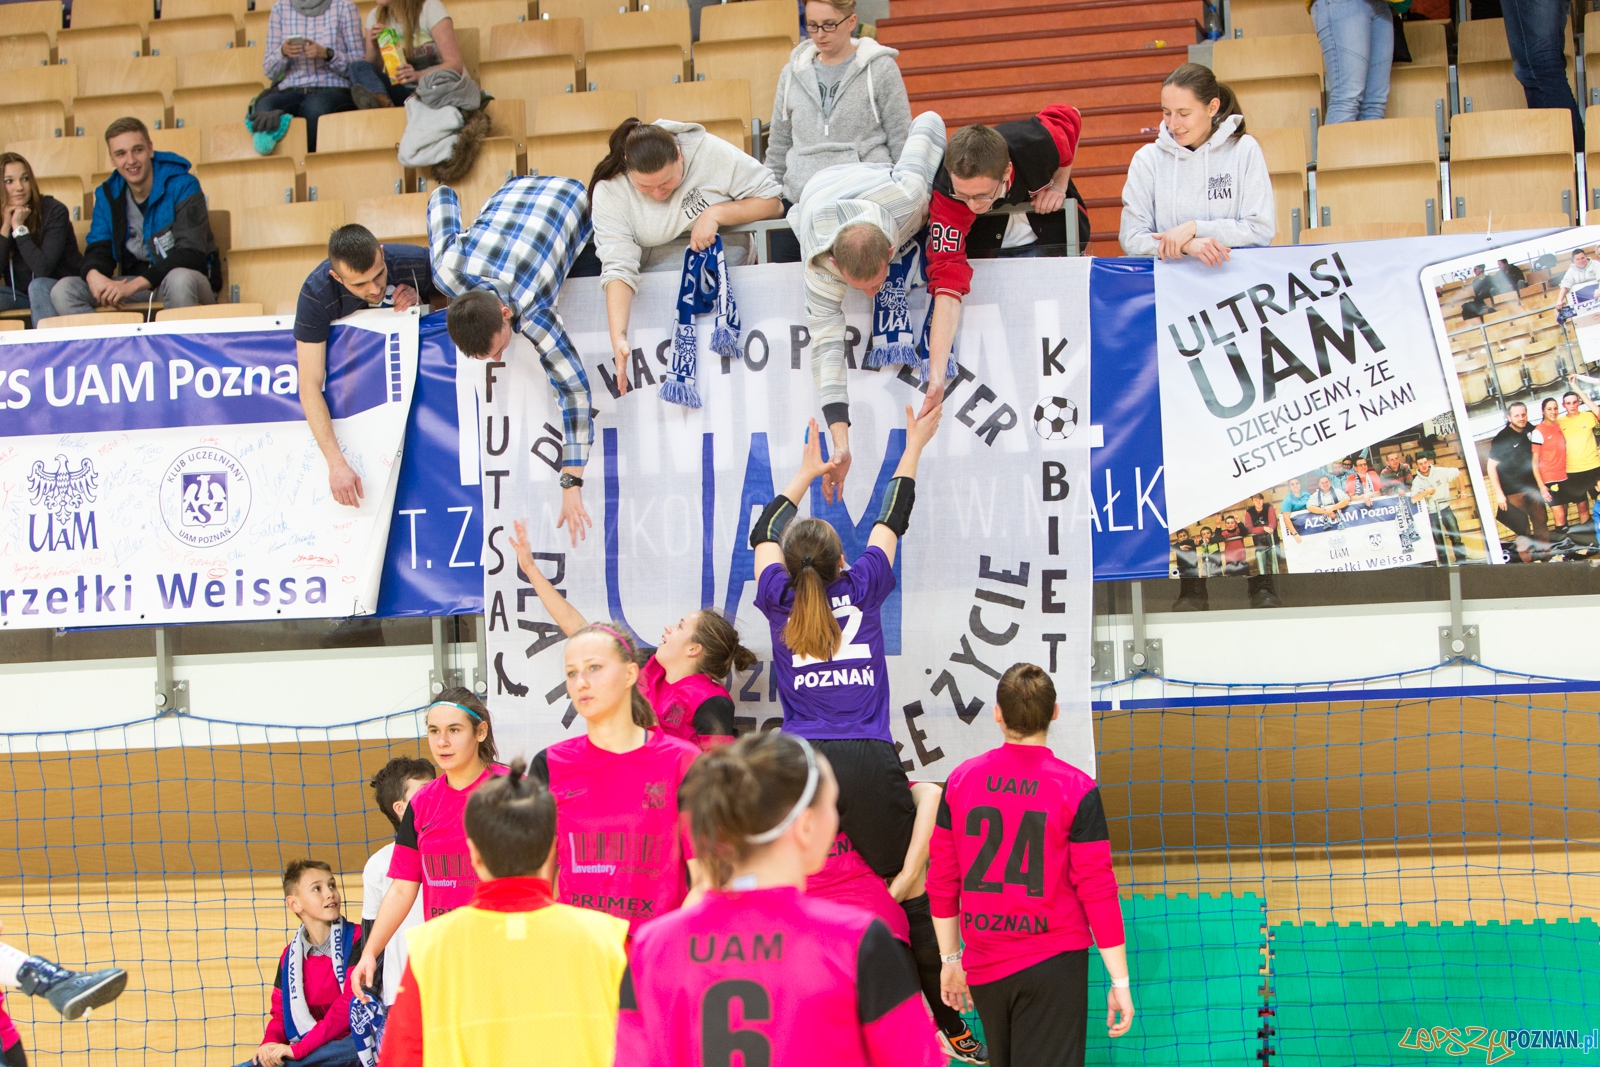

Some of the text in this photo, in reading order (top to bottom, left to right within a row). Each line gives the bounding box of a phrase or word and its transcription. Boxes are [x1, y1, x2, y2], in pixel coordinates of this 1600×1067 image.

[1208, 187, 1232, 200] UAM
[931, 222, 962, 252] 89
[1168, 252, 1353, 357] ULTRASI
[1187, 292, 1386, 419] UAM
[45, 360, 154, 407] UAM
[169, 358, 326, 401] Pozna
[1226, 359, 1395, 447] DZIĘKUJEMY, ŻE
[1232, 383, 1417, 478] JESTEŚCIE Z NAMI
[166, 459, 187, 484] KLUB
[187, 450, 246, 484] UCZELNIANY
[28, 511, 99, 552] UAM
[179, 529, 197, 543] UAM
[198, 527, 232, 544] POZNAŃ
[1366, 553, 1413, 569] Weissa
[156, 568, 327, 610] Weissa
[925, 555, 1030, 725] ŻYCIE
[794, 665, 875, 691] POZNAŃ
[986, 775, 1040, 796] UAM
[963, 805, 1048, 898] 24
[573, 863, 617, 876] inventory
[571, 893, 655, 913] PRIMEX
[963, 911, 1049, 934] POZNAŃ
[334, 929, 344, 960] 2003
[690, 932, 784, 963] UAM
[702, 978, 771, 1067] 6
